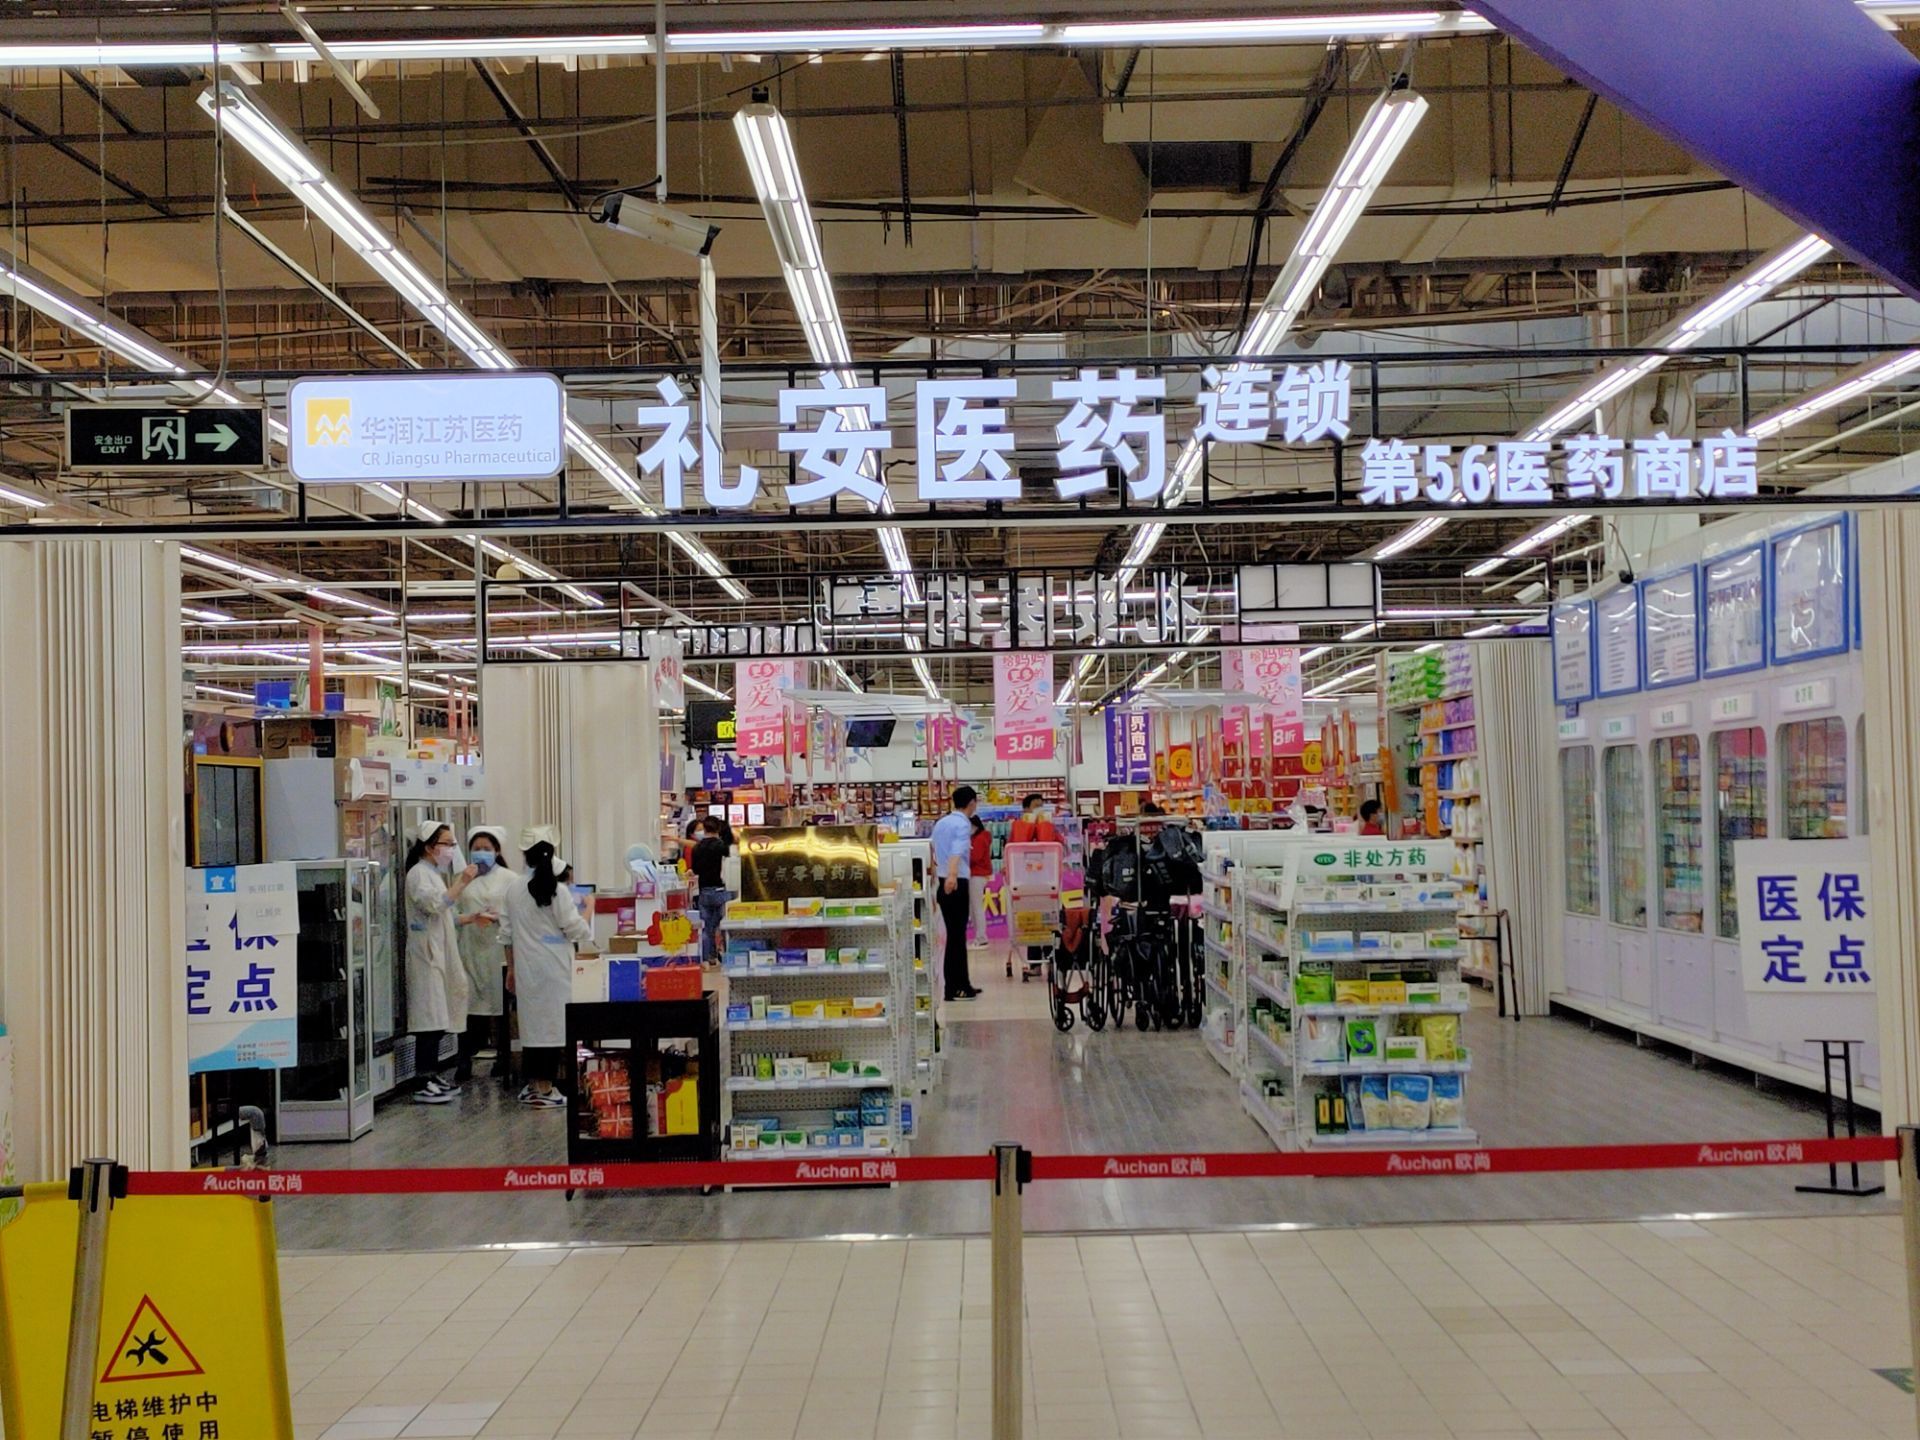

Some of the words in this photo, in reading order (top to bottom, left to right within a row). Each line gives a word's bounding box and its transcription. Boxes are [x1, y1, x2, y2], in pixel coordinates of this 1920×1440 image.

[94, 434, 133, 446] 安全出口
[361, 415, 523, 445] 华润江苏医药
[100, 445, 127, 454] EXIT
[361, 452, 381, 466] CR
[385, 451, 440, 469] Jiangsu
[445, 448, 556, 465] Pharmaceutical
[1360, 427, 1758, 505] 第56医药商店
[747, 680, 775, 710] 爱
[1004, 682, 1034, 715] 爱
[1008, 734, 1045, 754] 3.8折
[1343, 847, 1427, 868] 非处方药
[1757, 872, 1866, 921] 医保
[1761, 934, 1871, 983] 定点
[1386, 1153, 1453, 1171] Auchan
[1455, 1152, 1491, 1170] 欧尚
[1697, 1144, 1765, 1162] Auchan
[1767, 1143, 1803, 1161] 欧尚
[796, 1161, 860, 1179] Auchan
[862, 1161, 897, 1179] 欧尚
[1103, 1158, 1169, 1175] Auchan
[1170, 1157, 1206, 1175] 欧尚
[203, 1174, 266, 1191] Auchan
[268, 1174, 303, 1192] 欧尚
[504, 1169, 567, 1186] Auchan
[570, 1168, 605, 1186] 欧尚
[93, 1391, 218, 1422] 电梯维护中
